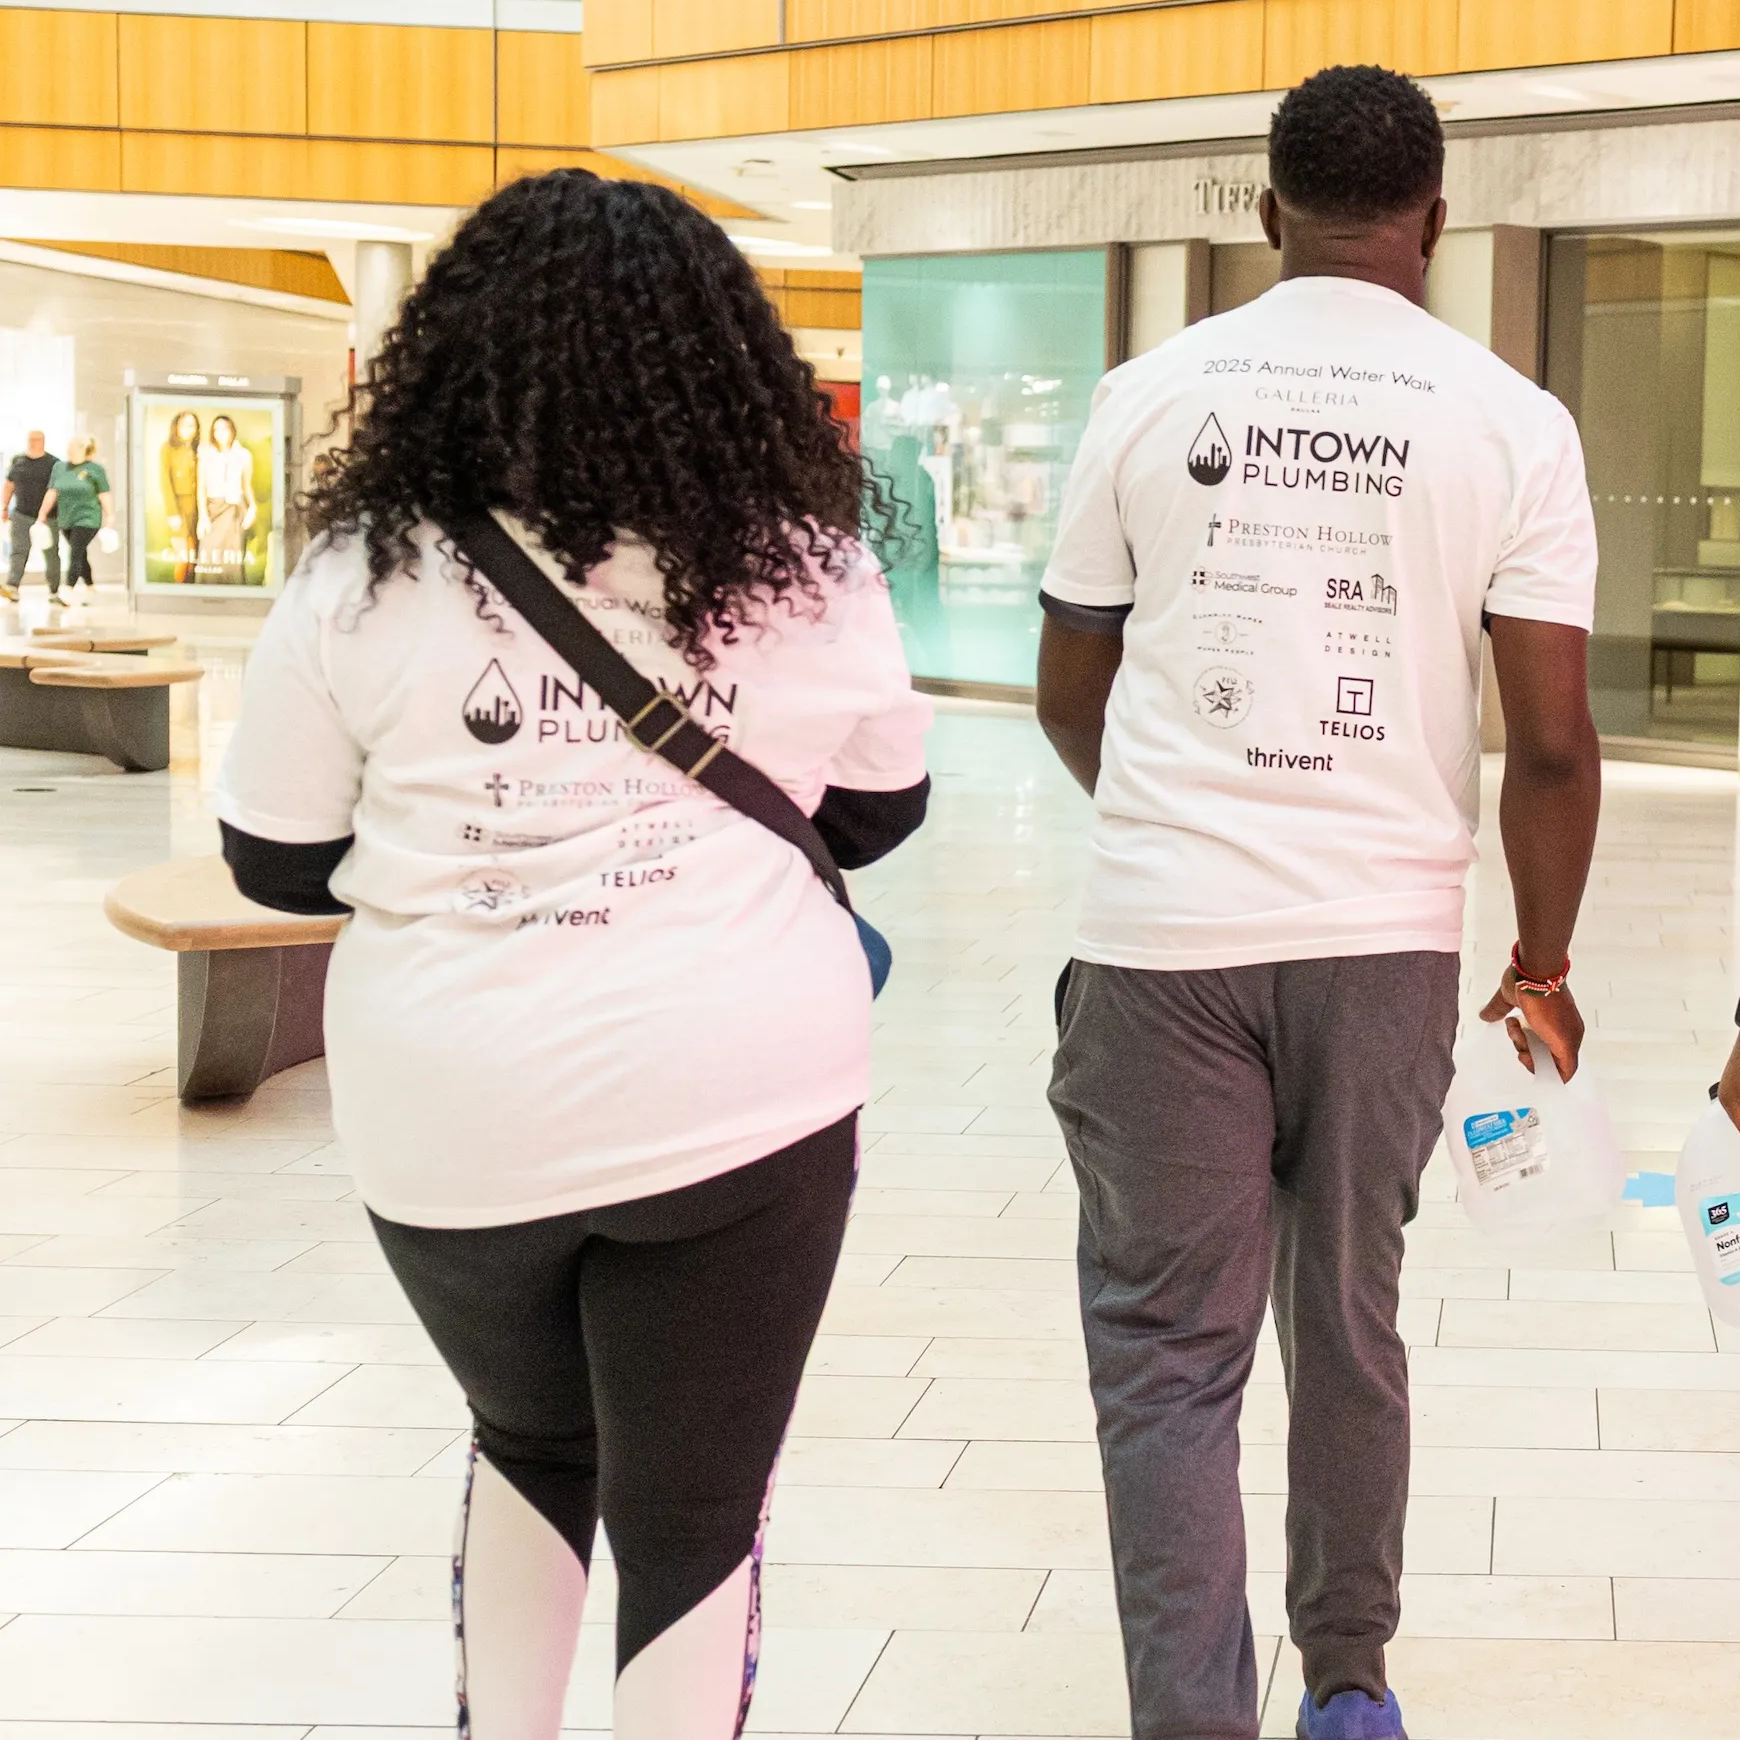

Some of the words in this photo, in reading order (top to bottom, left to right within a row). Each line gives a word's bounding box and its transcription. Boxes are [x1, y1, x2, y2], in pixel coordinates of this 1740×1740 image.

[1194, 177, 1264, 214] TIFF
[1203, 358, 1252, 375] 2025
[1257, 361, 1323, 378] Annual
[1330, 364, 1385, 382] Water
[1391, 371, 1437, 394] Walk
[1255, 387, 1360, 406] GALLERIA
[1245, 425, 1410, 470] INTOWN
[1243, 463, 1404, 498] PLUMBING
[1228, 518, 1310, 541] PRESTON
[1316, 525, 1394, 547] HOLLOW
[1226, 538, 1314, 552] PRESBYTERIAN
[1320, 544, 1368, 556] CHURCH
[1214, 580, 1259, 593] Medical
[1260, 583, 1298, 598] Group
[1326, 578, 1364, 601] SRA
[1326, 631, 1392, 645] ATWELL
[1324, 645, 1391, 658] DESIGN
[1319, 720, 1386, 741] TELIOS
[1247, 746, 1334, 772] thrivent
[519, 779, 614, 798] PRESTON
[600, 866, 679, 888] TELIOS
[1710, 1205, 1728, 1220] 365
